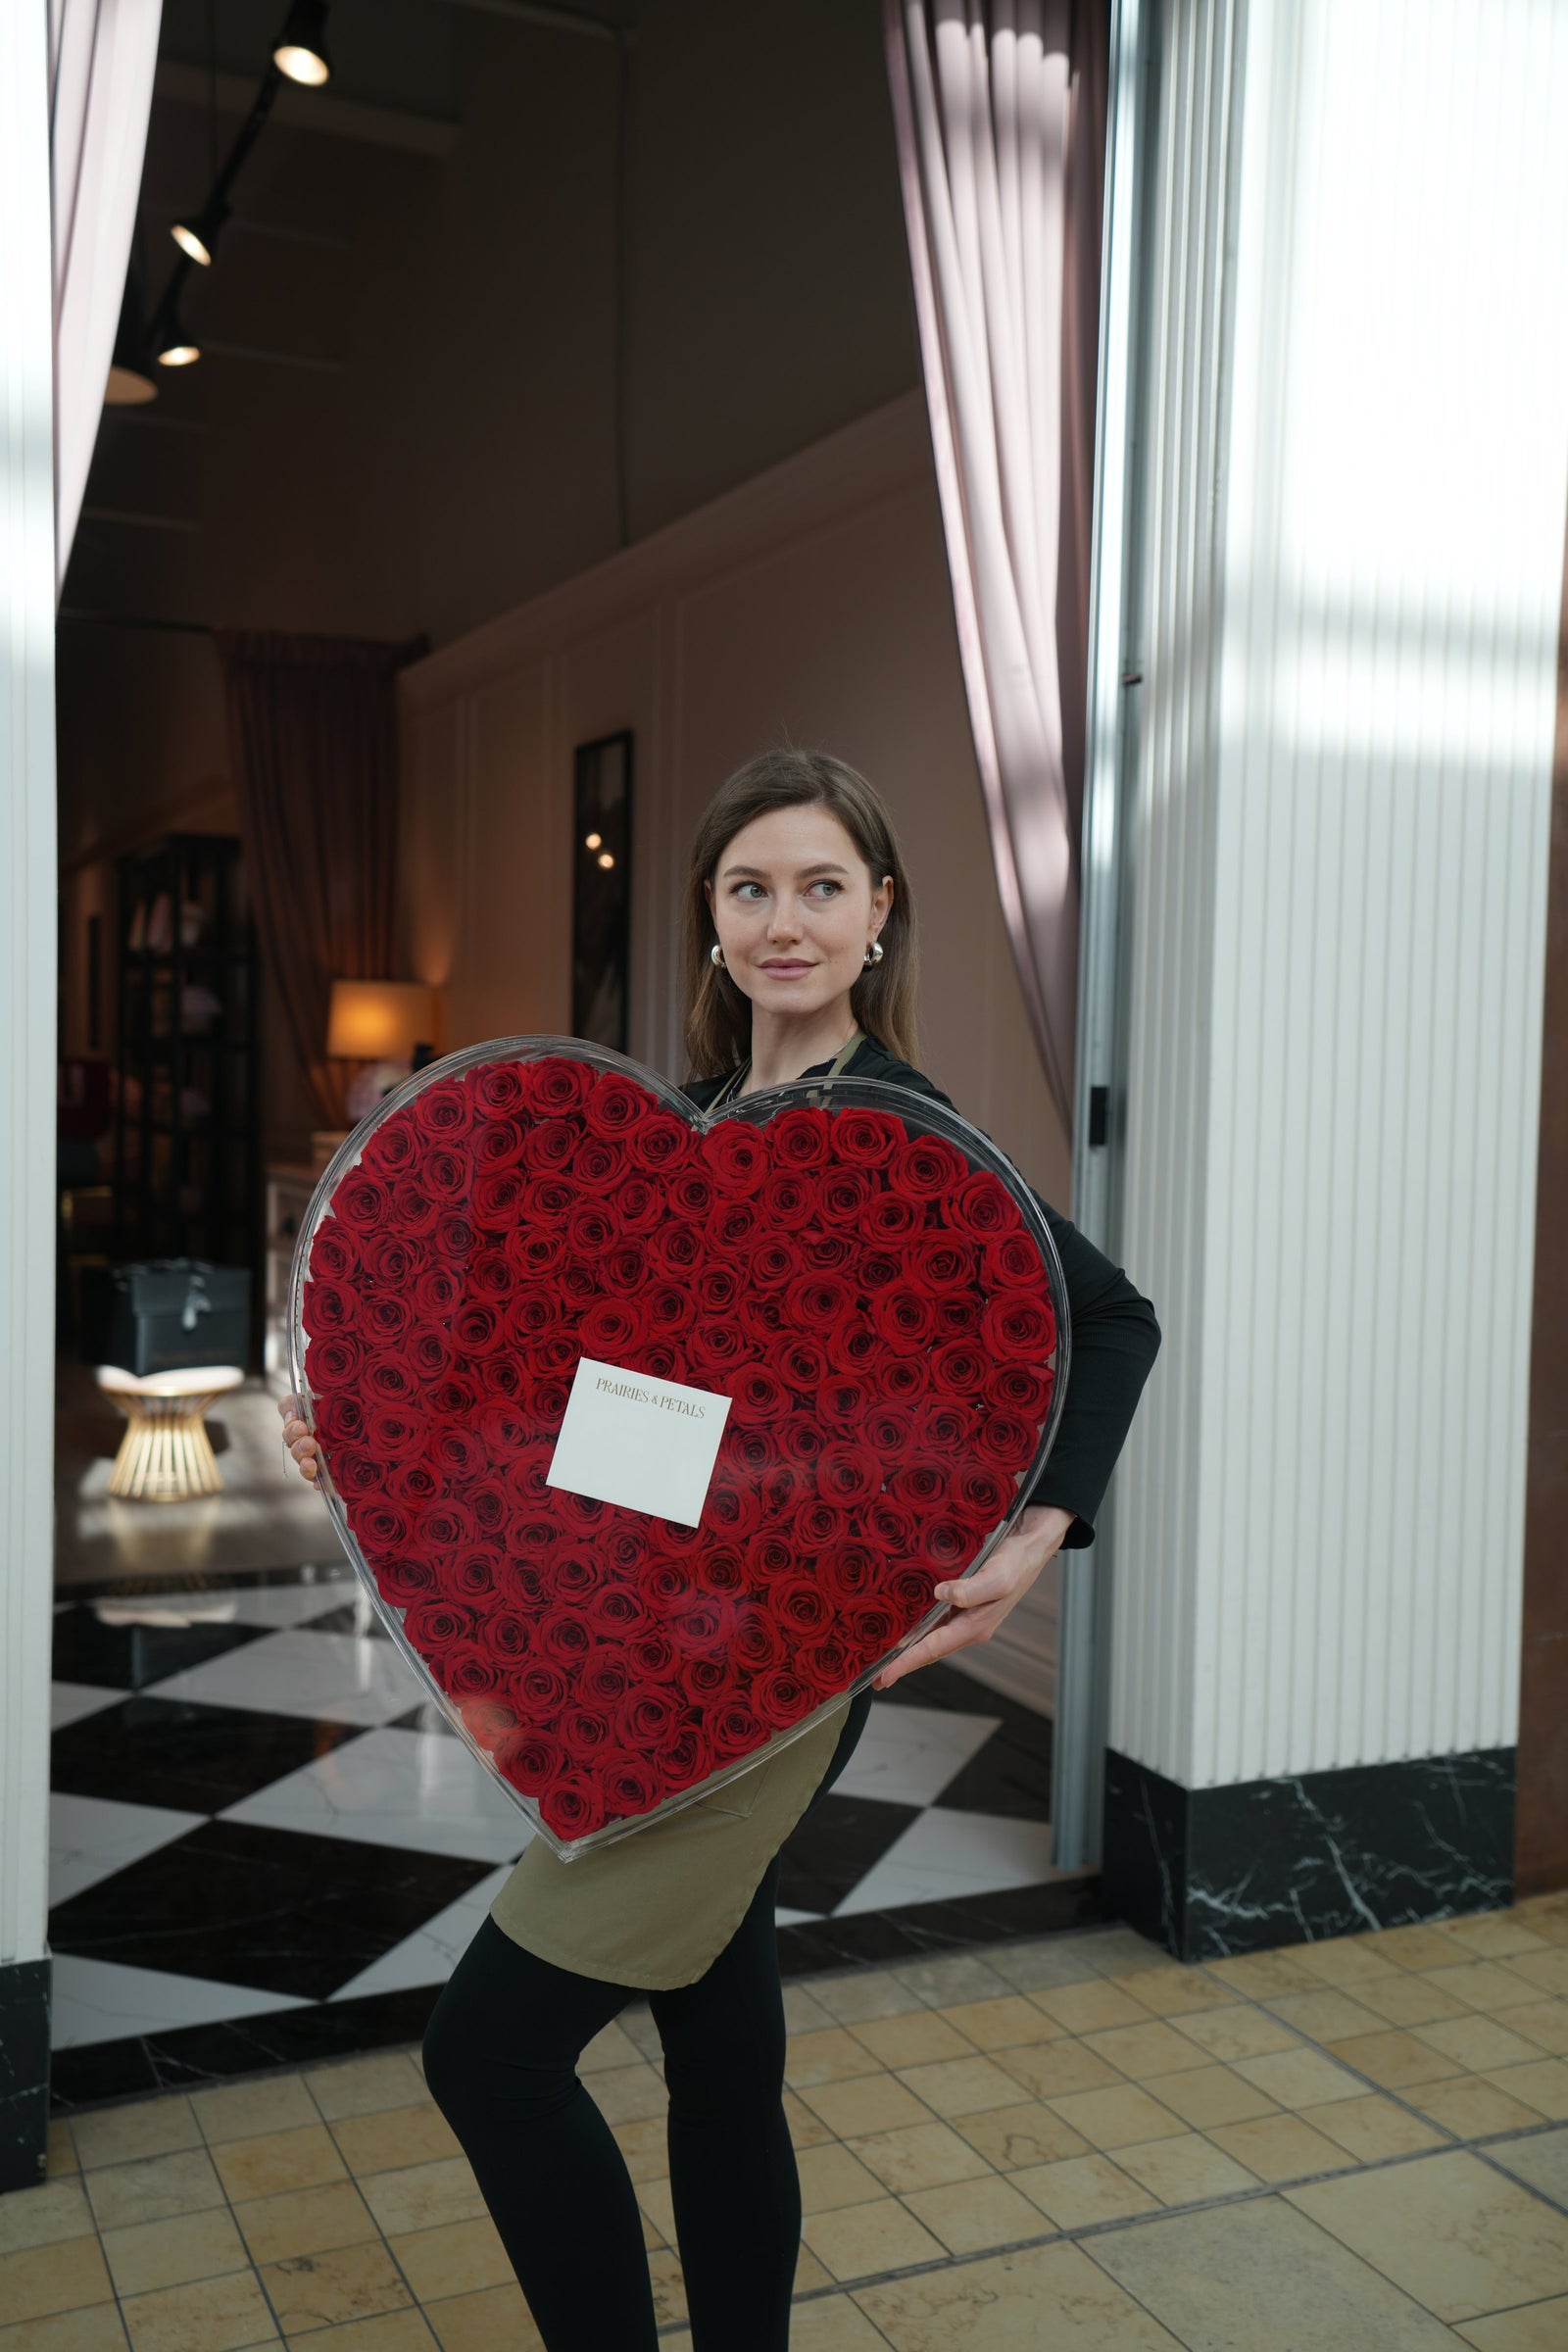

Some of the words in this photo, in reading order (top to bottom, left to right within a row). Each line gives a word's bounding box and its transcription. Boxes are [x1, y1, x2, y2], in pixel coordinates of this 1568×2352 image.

[596, 1378, 650, 1402] PRAIRIES
[651, 1395, 659, 1404] &
[660, 1396, 706, 1419] PETALS
